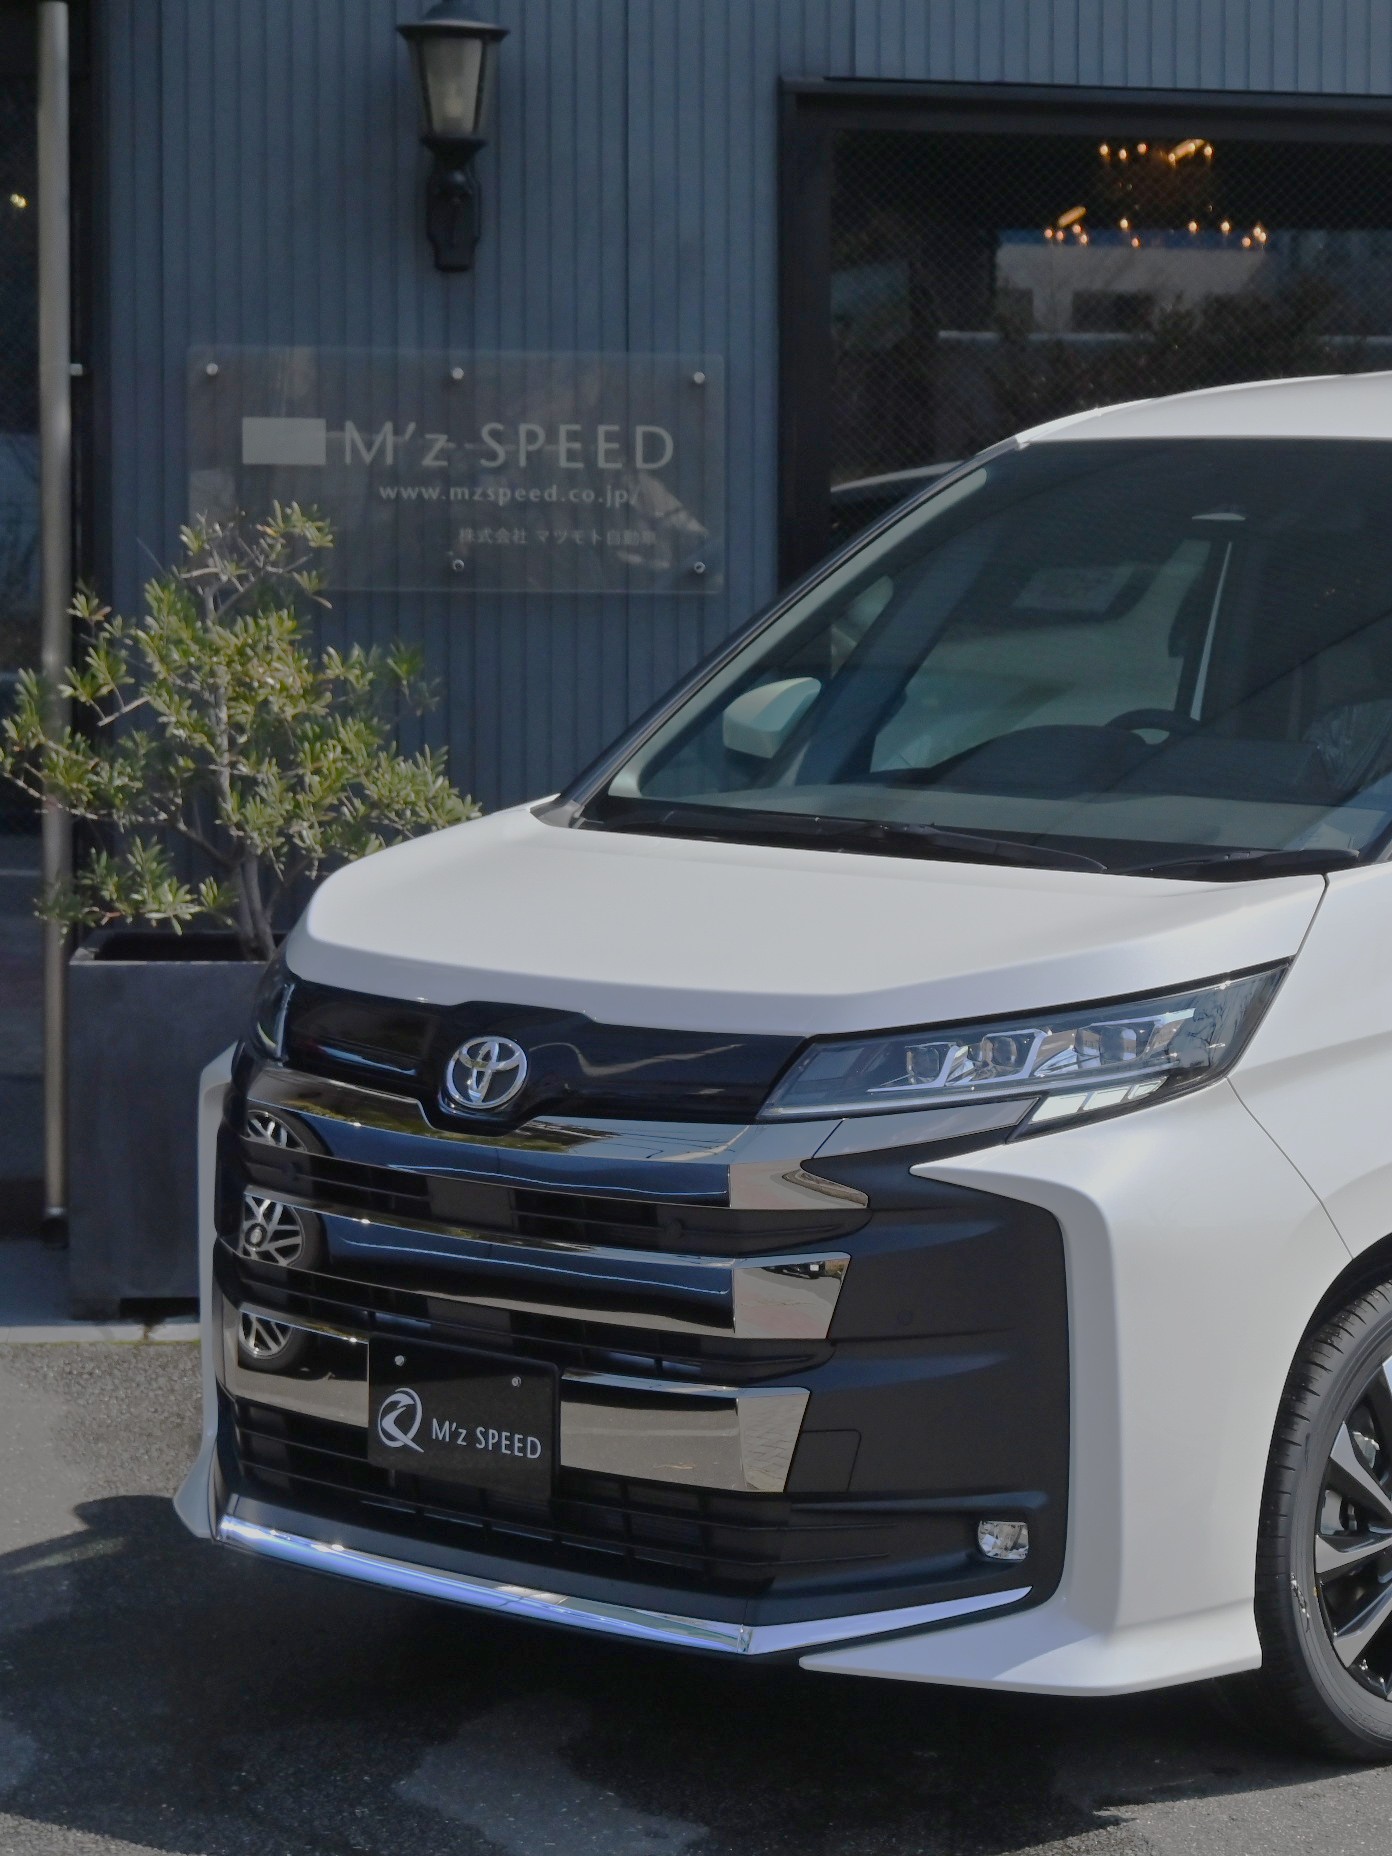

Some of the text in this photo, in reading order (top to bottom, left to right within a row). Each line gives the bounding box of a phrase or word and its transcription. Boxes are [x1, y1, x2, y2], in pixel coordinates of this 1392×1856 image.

[344, 420, 675, 470] M'z SPEED
[432, 1417, 542, 1459] M'z SPEED
